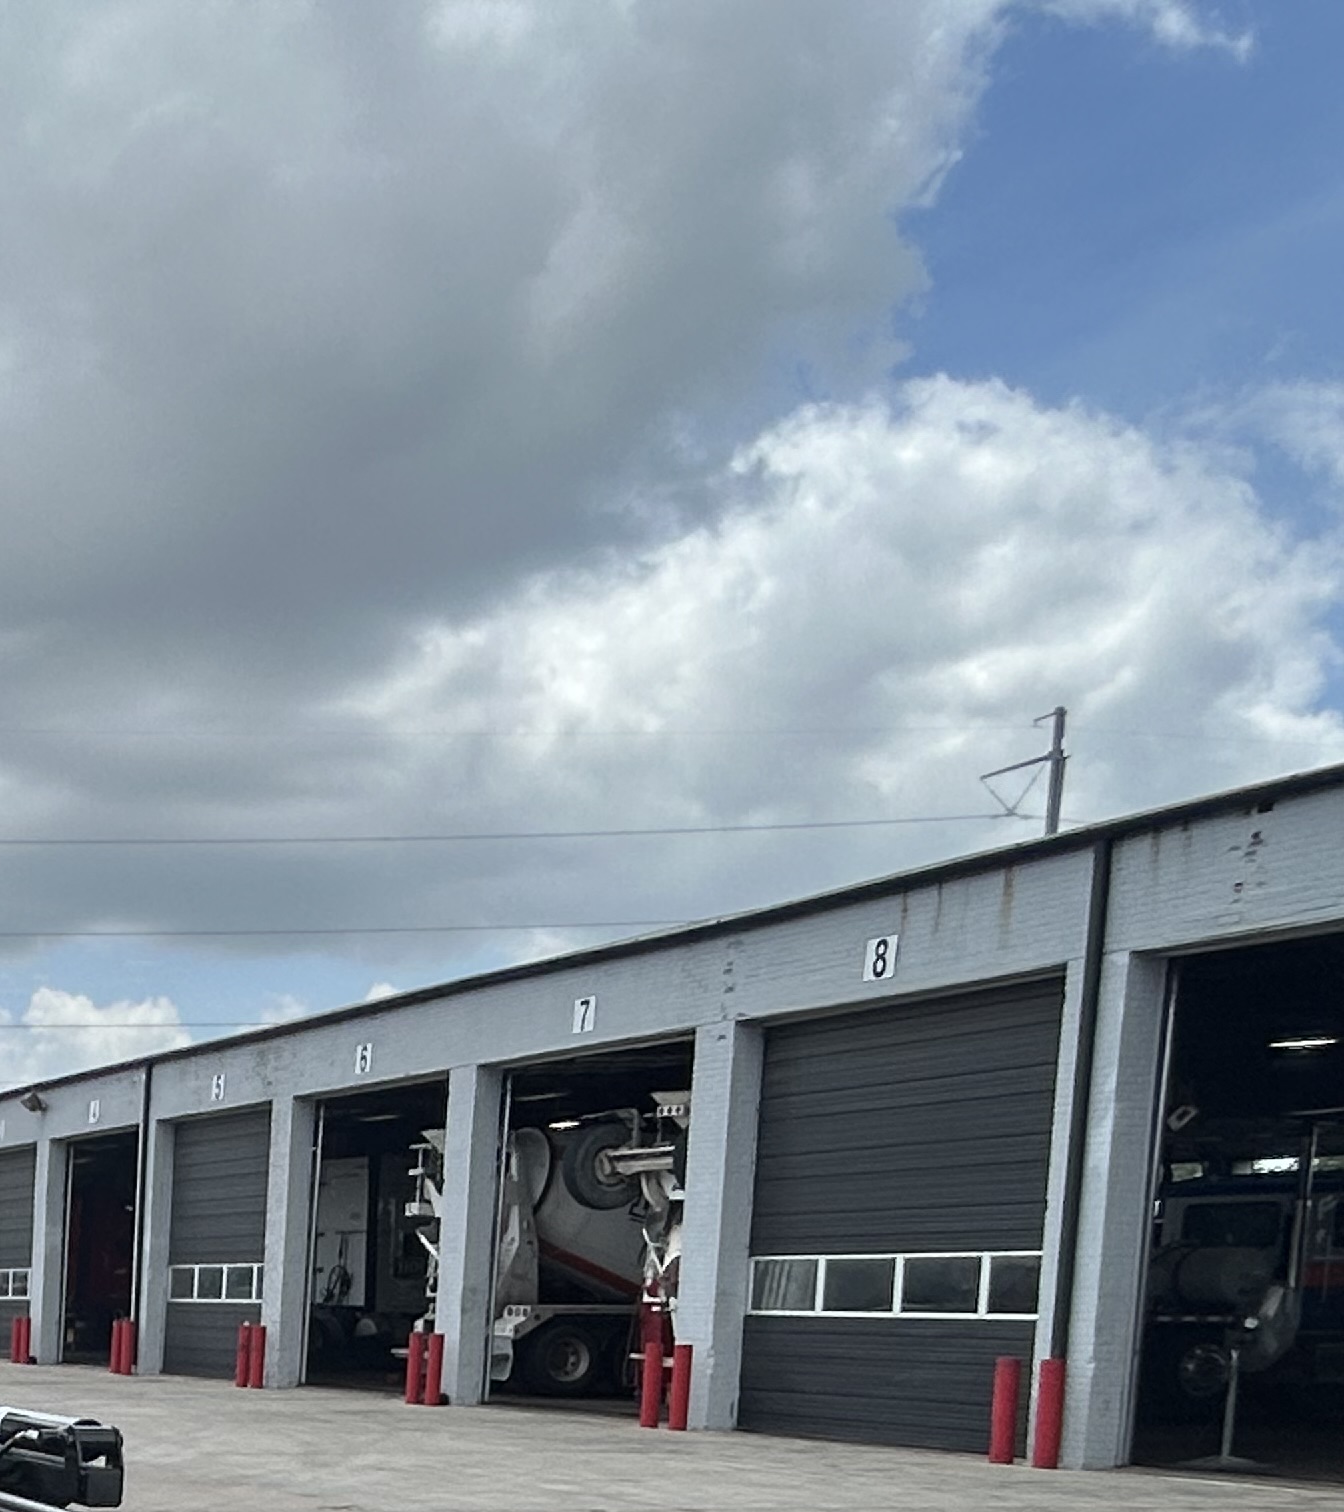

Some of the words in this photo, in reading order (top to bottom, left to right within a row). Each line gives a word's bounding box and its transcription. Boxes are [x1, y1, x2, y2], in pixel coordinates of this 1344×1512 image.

[872, 938, 888, 978] 8
[580, 999, 590, 1032] 7
[360, 1045, 368, 1072] 6
[214, 1074, 222, 1100] 5
